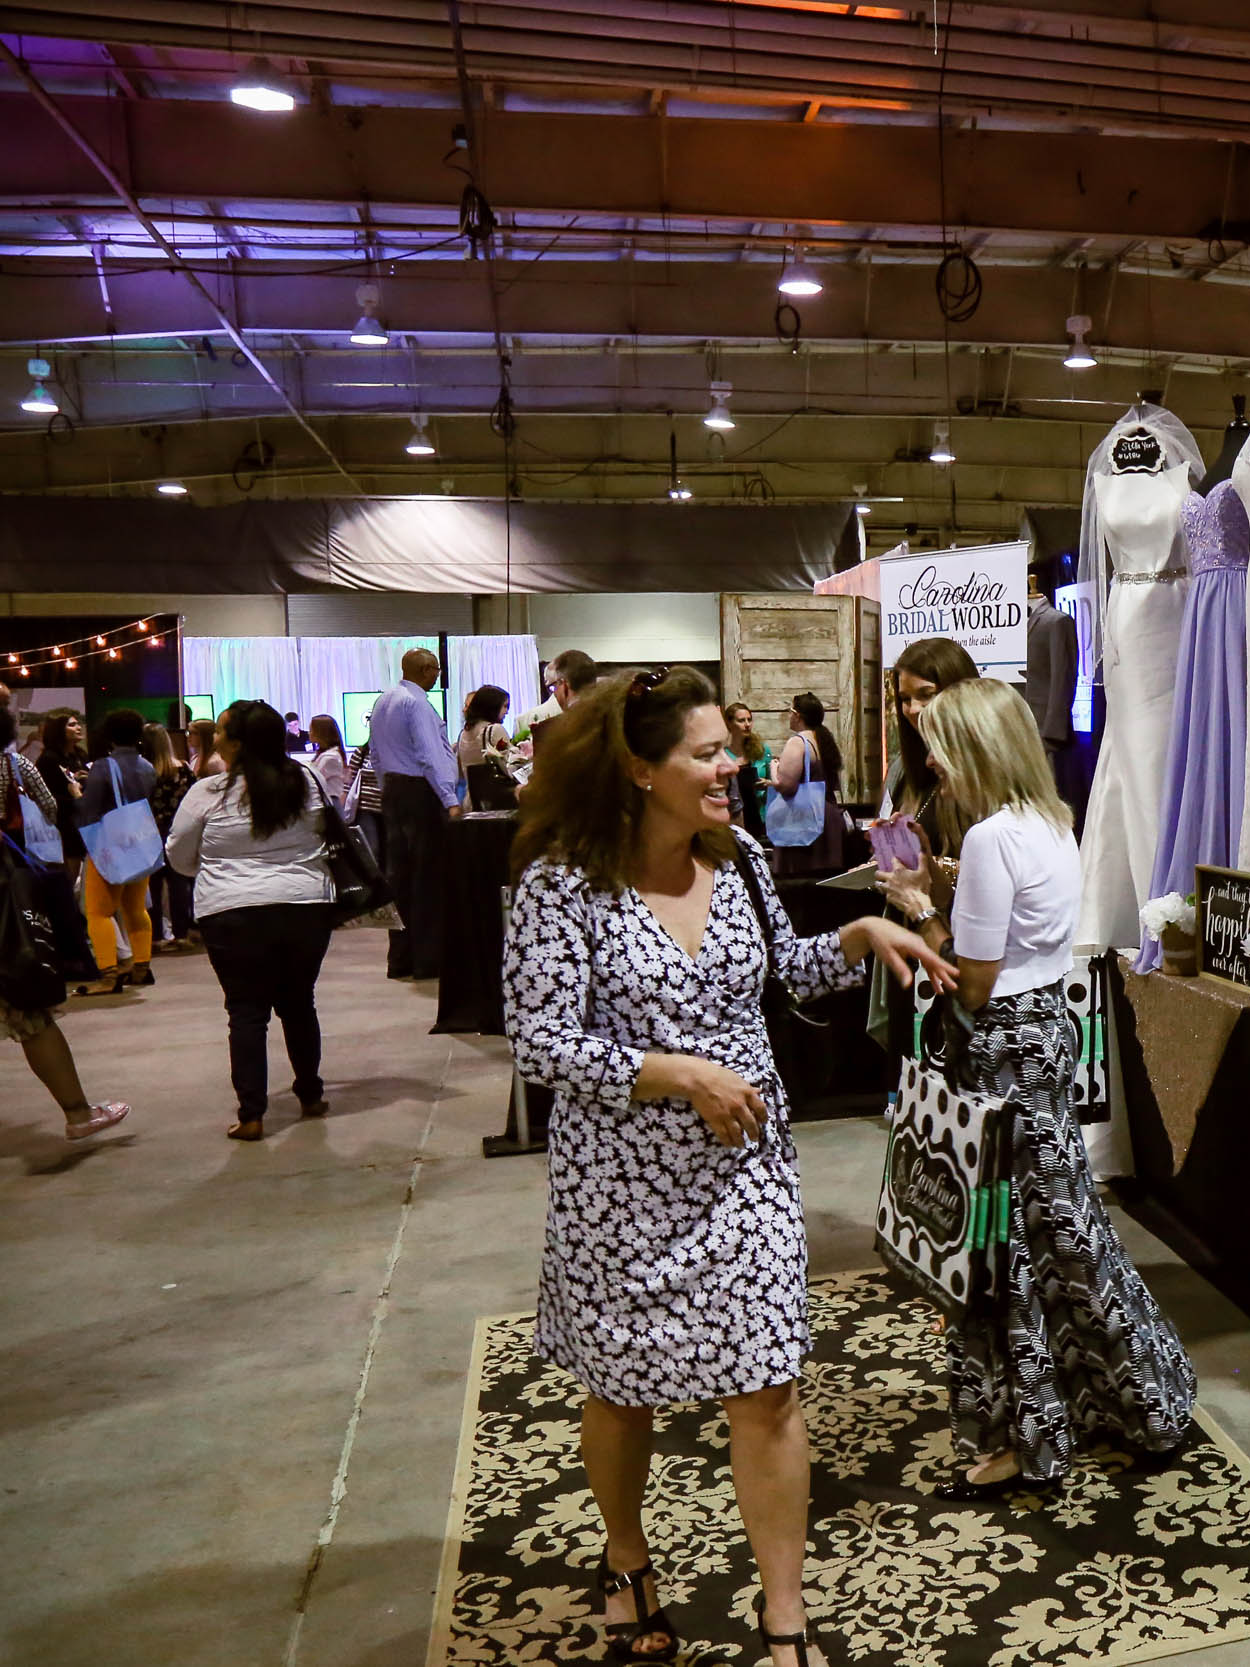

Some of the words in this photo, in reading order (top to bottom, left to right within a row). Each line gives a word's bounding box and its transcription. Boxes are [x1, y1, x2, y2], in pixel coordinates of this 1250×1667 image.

[1141, 441, 1156, 451] York
[898, 565, 1008, 612] Carolina
[887, 609, 950, 636] BRIDAL
[951, 603, 1022, 631] WORLD
[968, 635, 979, 647] the
[980, 633, 997, 646] aisle
[1217, 880, 1230, 900] and
[1232, 884, 1246, 913] they
[1212, 957, 1227, 971] ever
[1228, 955, 1248, 985] after
